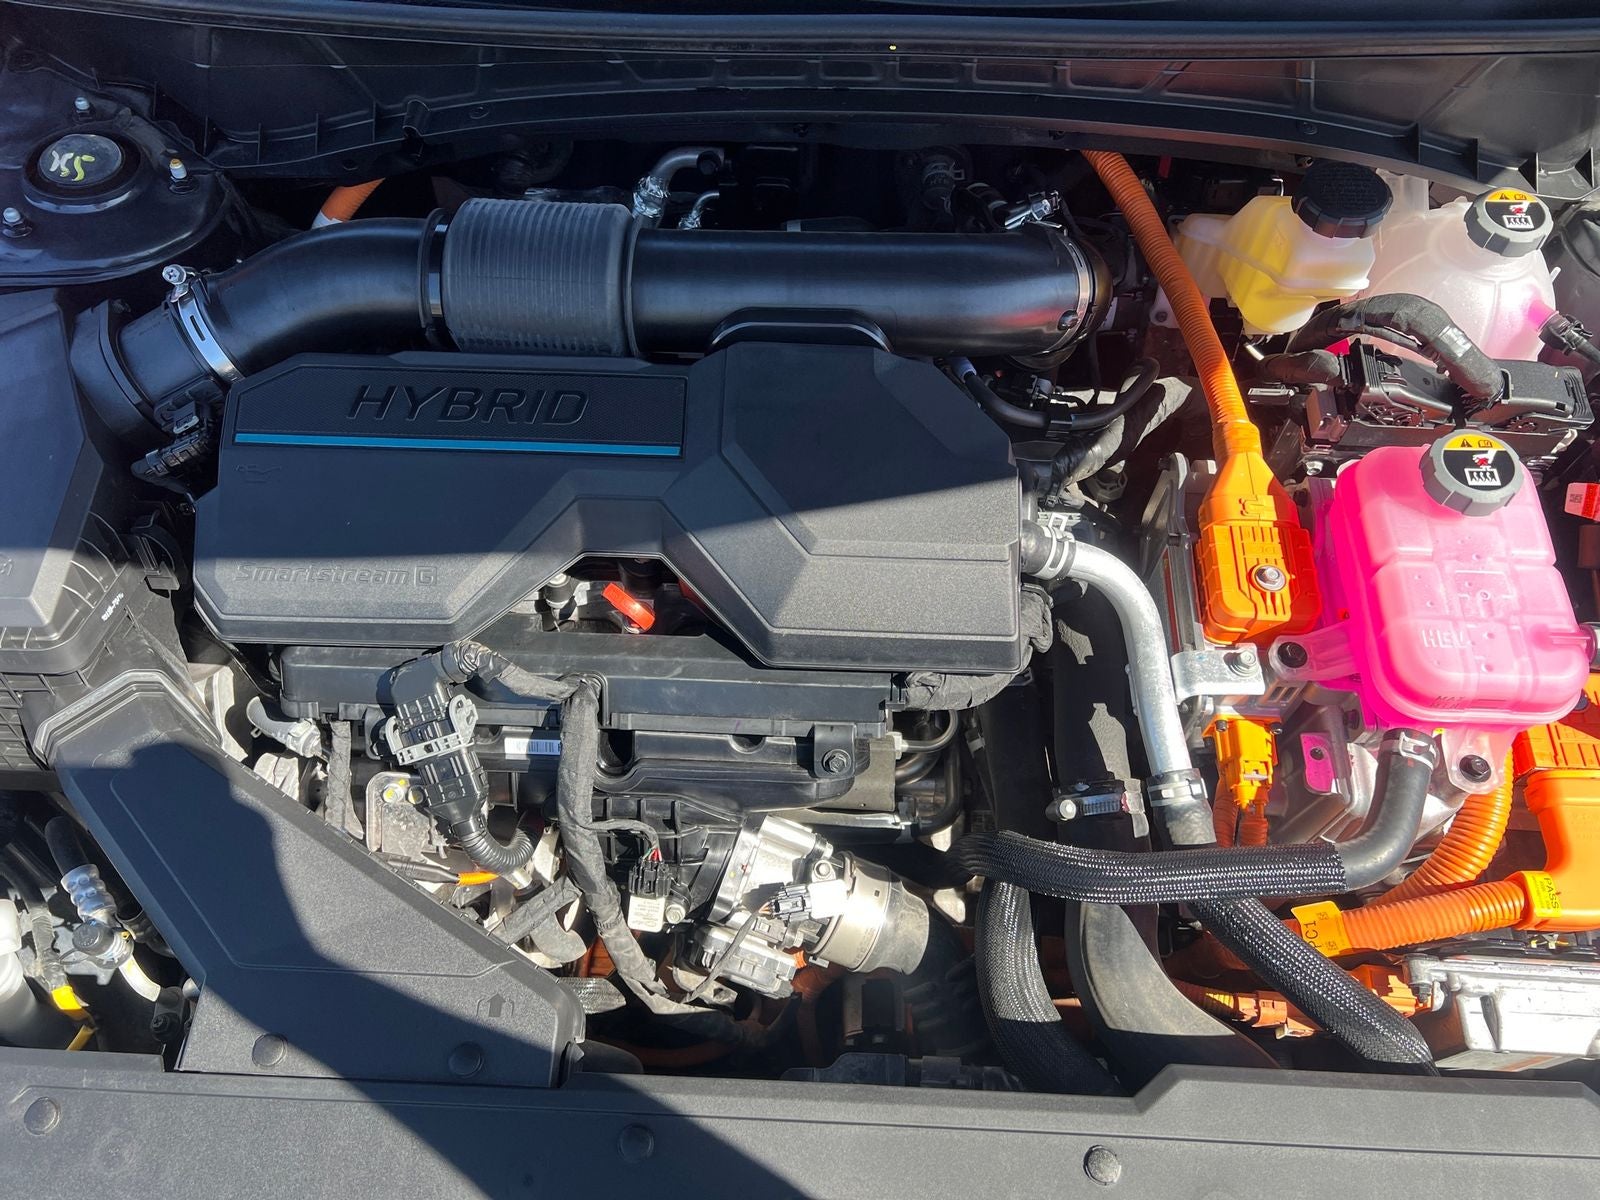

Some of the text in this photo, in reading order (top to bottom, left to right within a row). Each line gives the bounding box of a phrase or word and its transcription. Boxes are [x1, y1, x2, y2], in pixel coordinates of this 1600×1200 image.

[346, 384, 590, 426] HYBRID
[234, 564, 438, 586] Smartstream G
[1543, 877, 1560, 909] PASS
